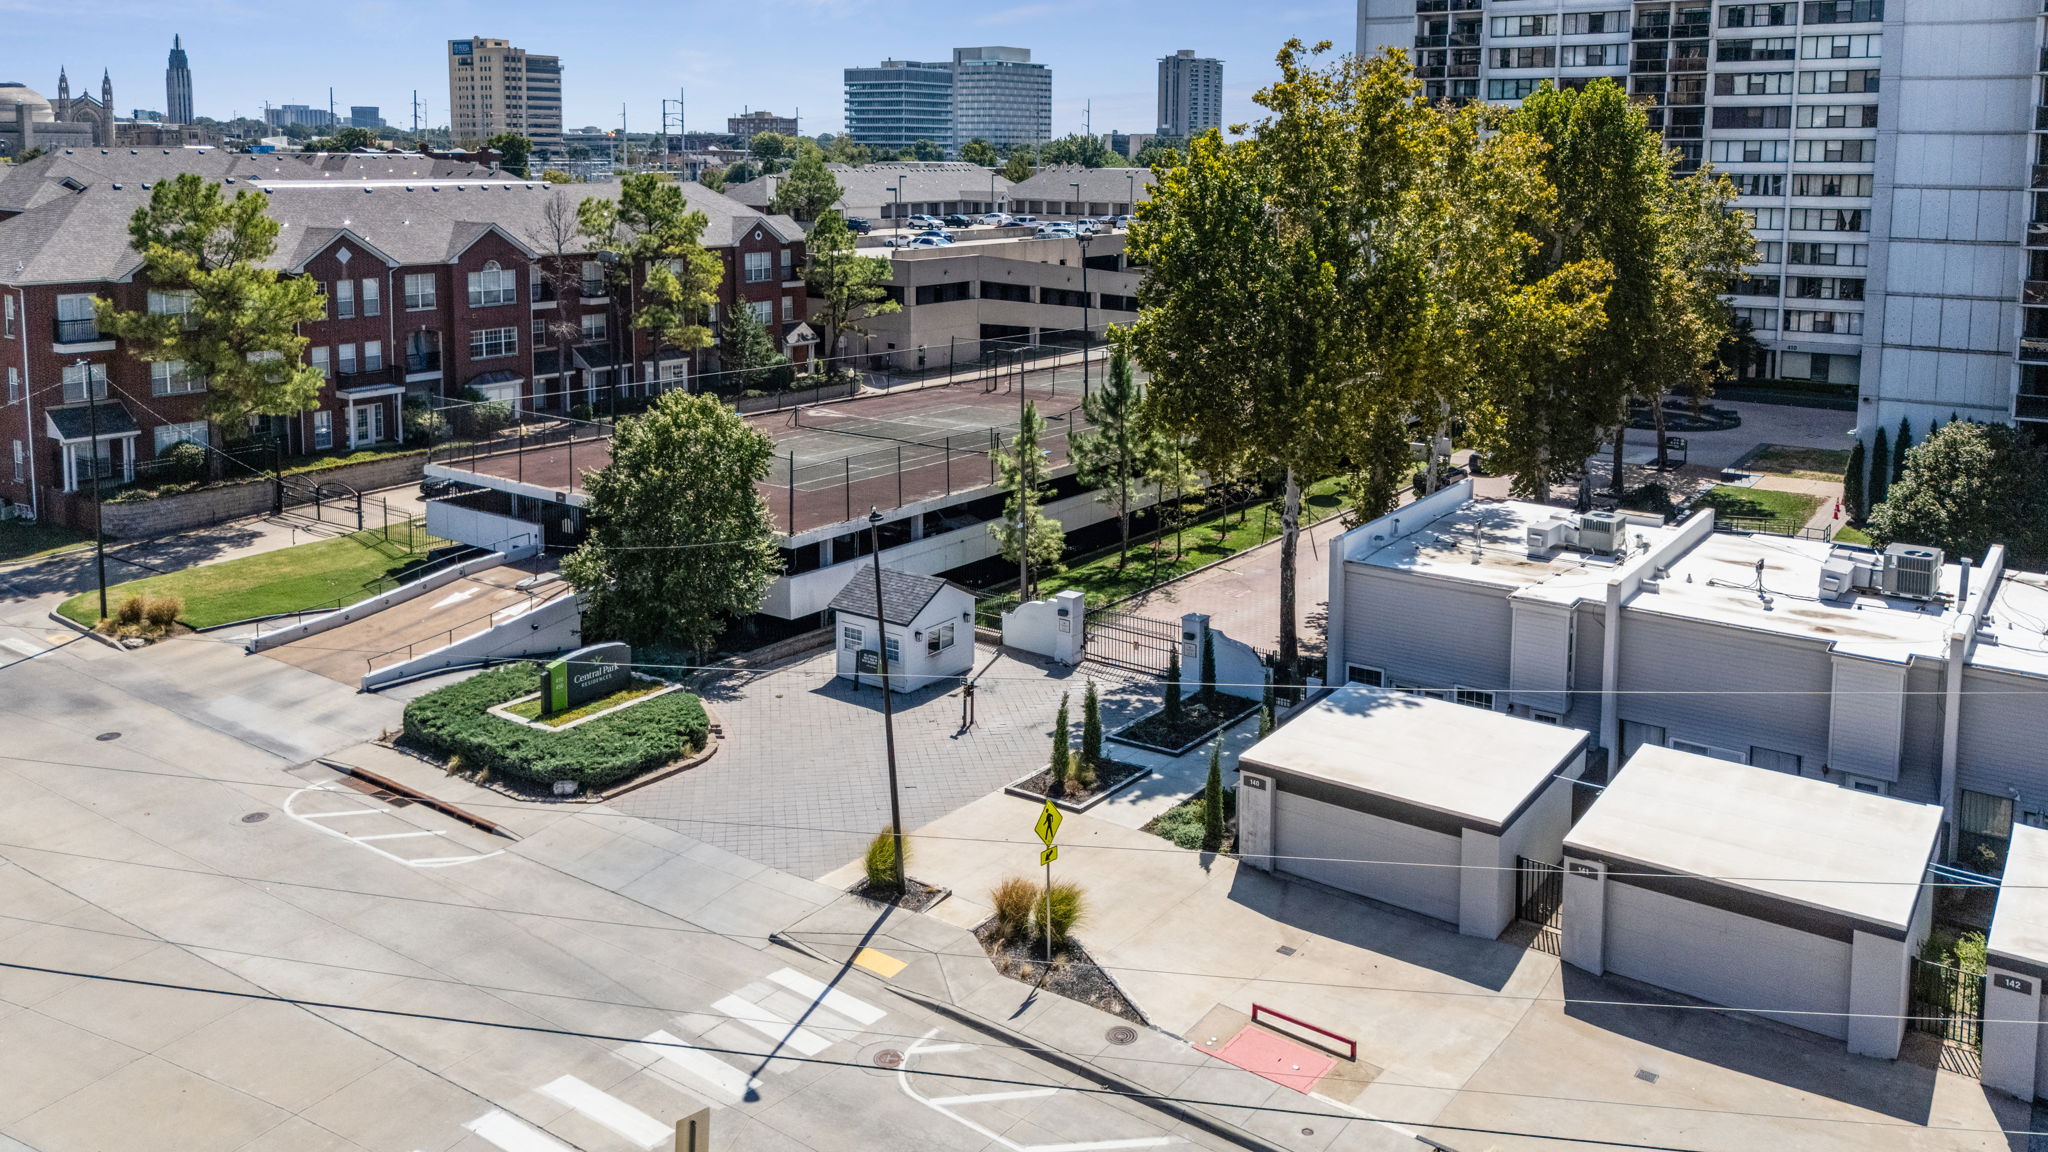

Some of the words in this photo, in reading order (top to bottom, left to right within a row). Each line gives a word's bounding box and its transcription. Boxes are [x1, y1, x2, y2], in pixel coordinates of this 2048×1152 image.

[574, 666, 602, 684] Central
[603, 662, 620, 674] Park
[581, 673, 613, 688] RESIDENCES
[1250, 779, 1260, 787] 140
[2005, 979, 2021, 990] 142
